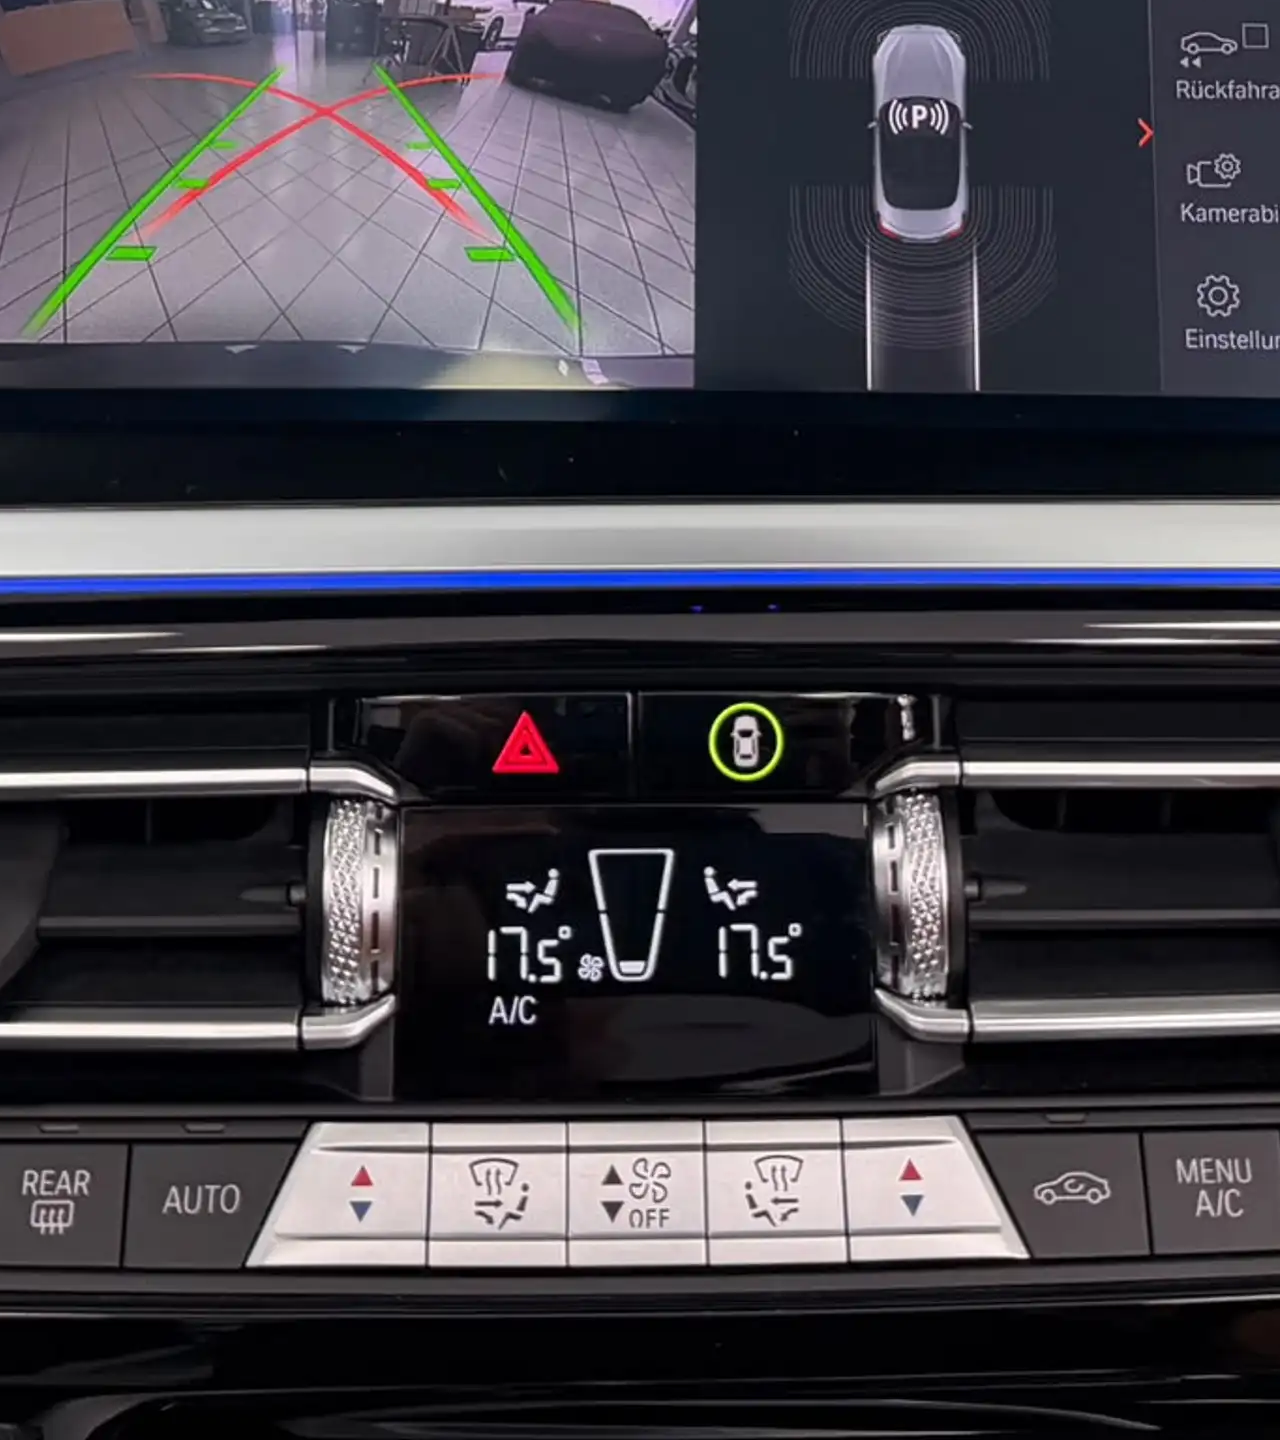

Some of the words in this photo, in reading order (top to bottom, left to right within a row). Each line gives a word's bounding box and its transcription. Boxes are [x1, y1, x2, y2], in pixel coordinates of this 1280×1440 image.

[488, 995, 538, 1025] A/C
[22, 1169, 91, 1197] REAR
[1176, 1158, 1252, 1185] MENU
[161, 1184, 241, 1215] AUTO
[1195, 1188, 1245, 1218] A/C
[628, 1208, 671, 1229] OFF
